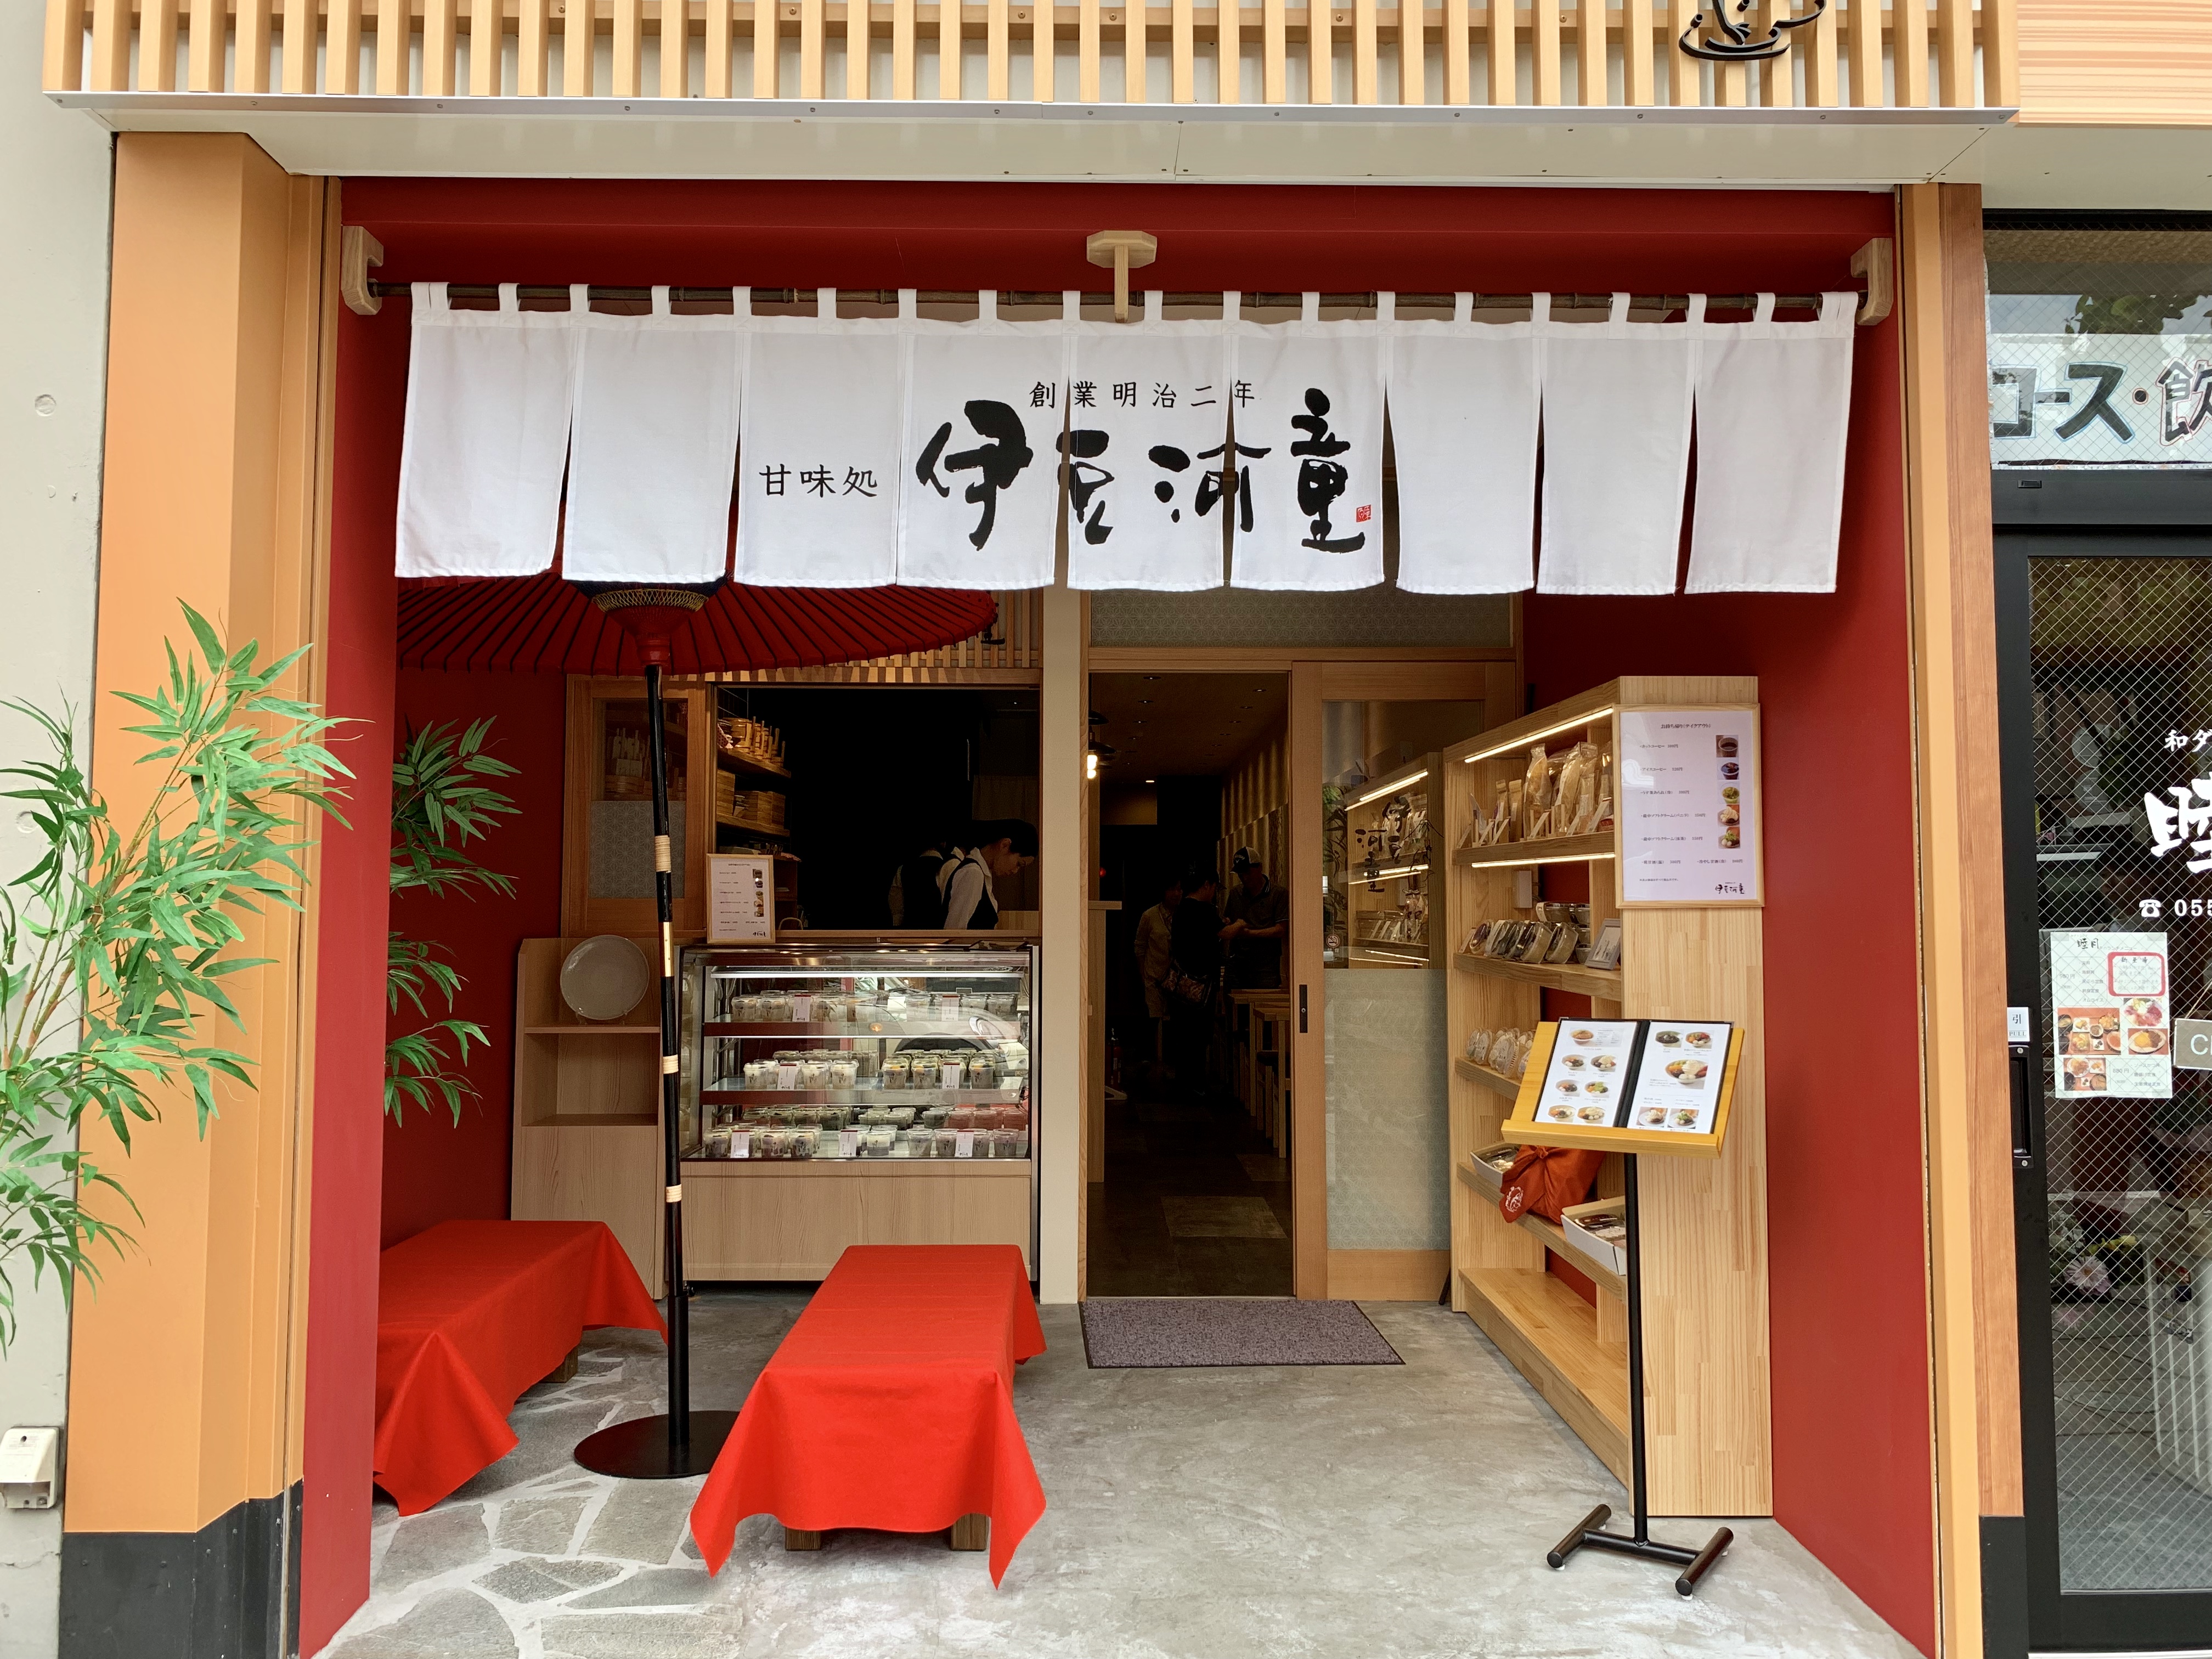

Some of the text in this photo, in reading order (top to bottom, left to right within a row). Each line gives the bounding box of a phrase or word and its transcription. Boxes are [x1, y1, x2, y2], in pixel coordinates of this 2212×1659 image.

[1029, 381, 1255, 409] 創業明治二年
[759, 464, 879, 498] 甘味処
[916, 387, 1365, 554] 伊豆河童
[2012, 1014, 2021, 1025] 引
